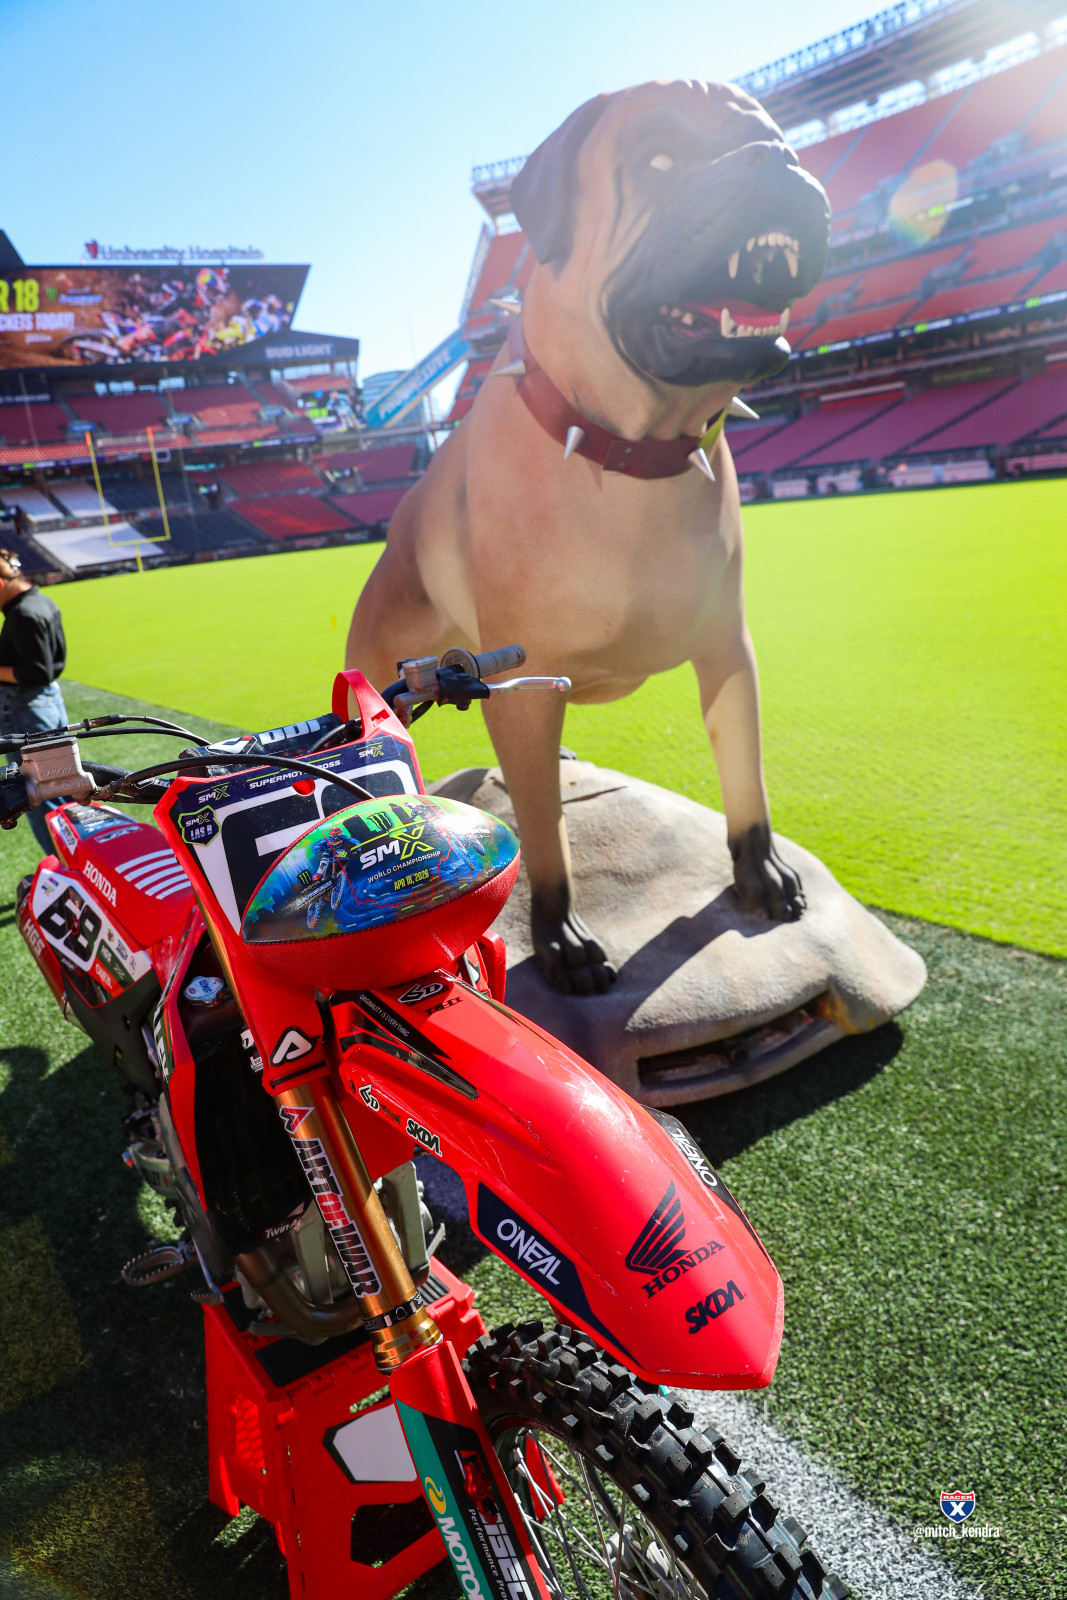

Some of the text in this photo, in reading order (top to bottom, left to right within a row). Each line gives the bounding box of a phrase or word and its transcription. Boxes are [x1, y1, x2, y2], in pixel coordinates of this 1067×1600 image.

[101, 244, 264, 261] University Hospitals
[12, 278, 39, 313] 18
[265, 343, 332, 359] BUD LIGHT
[359, 743, 385, 758] SMX
[198, 783, 231, 804] SMX
[186, 811, 210, 827] SMX
[360, 824, 435, 870] SMX
[83, 860, 117, 907] HONDA
[367, 850, 441, 883] WORLD CHAMPIONSHIP
[394, 878, 407, 891] APR
[414, 869, 430, 883] 2026
[37, 885, 102, 963] 68
[359, 994, 383, 1016] ORIGINALITY
[385, 1014, 410, 1038] EVERYTHING
[406, 1118, 442, 1157] SKDA
[641, 1239, 725, 1299] HONDA
[685, 1279, 745, 1334] SKDA
[468, 1508, 509, 1600] Performance Pro
